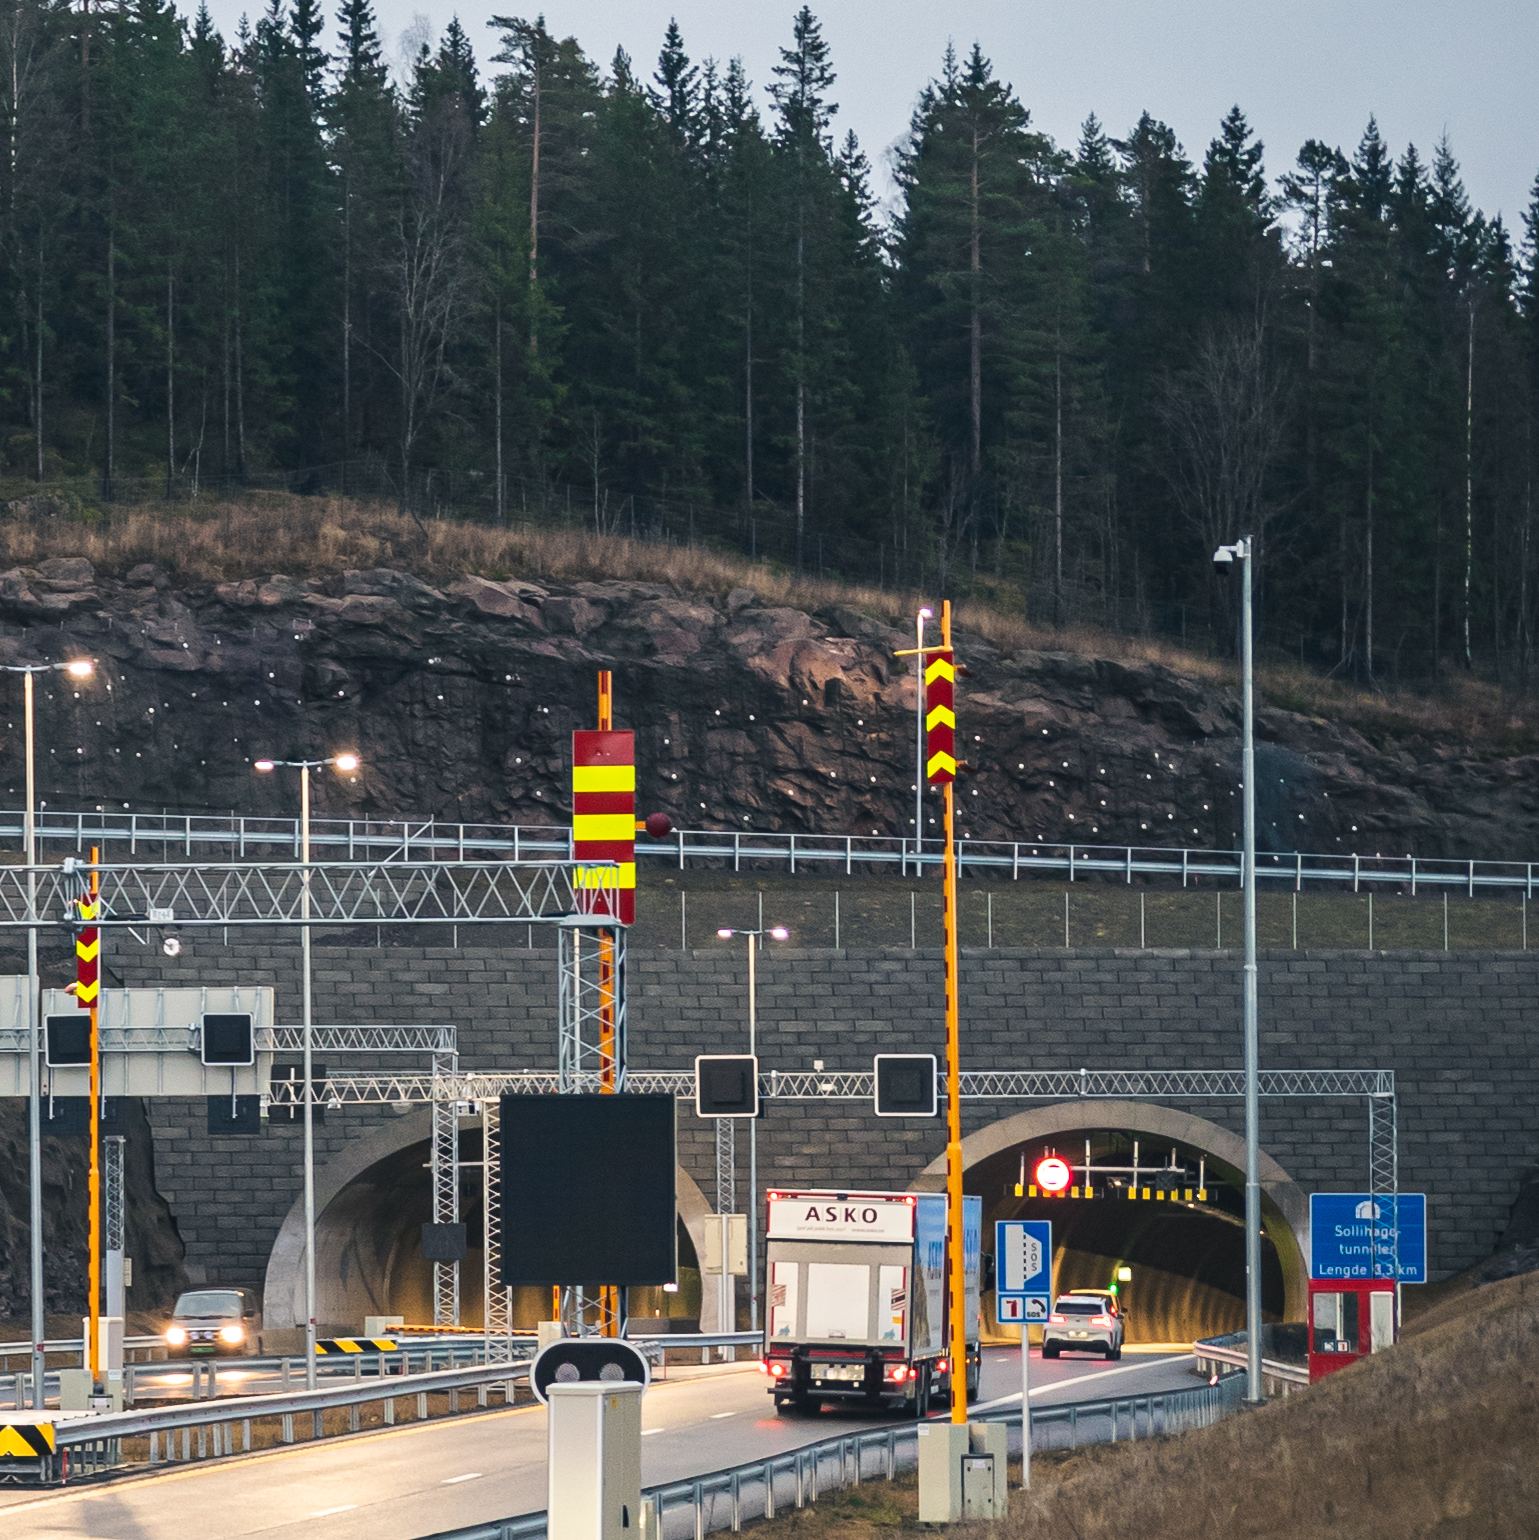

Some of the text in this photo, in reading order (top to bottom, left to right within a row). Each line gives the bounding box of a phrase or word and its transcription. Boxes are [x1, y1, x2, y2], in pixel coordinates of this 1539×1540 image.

[804, 1205, 879, 1224] ASKO
[1030, 1242, 1038, 1272] SOS
[1319, 1263, 1368, 1278] Lengde
